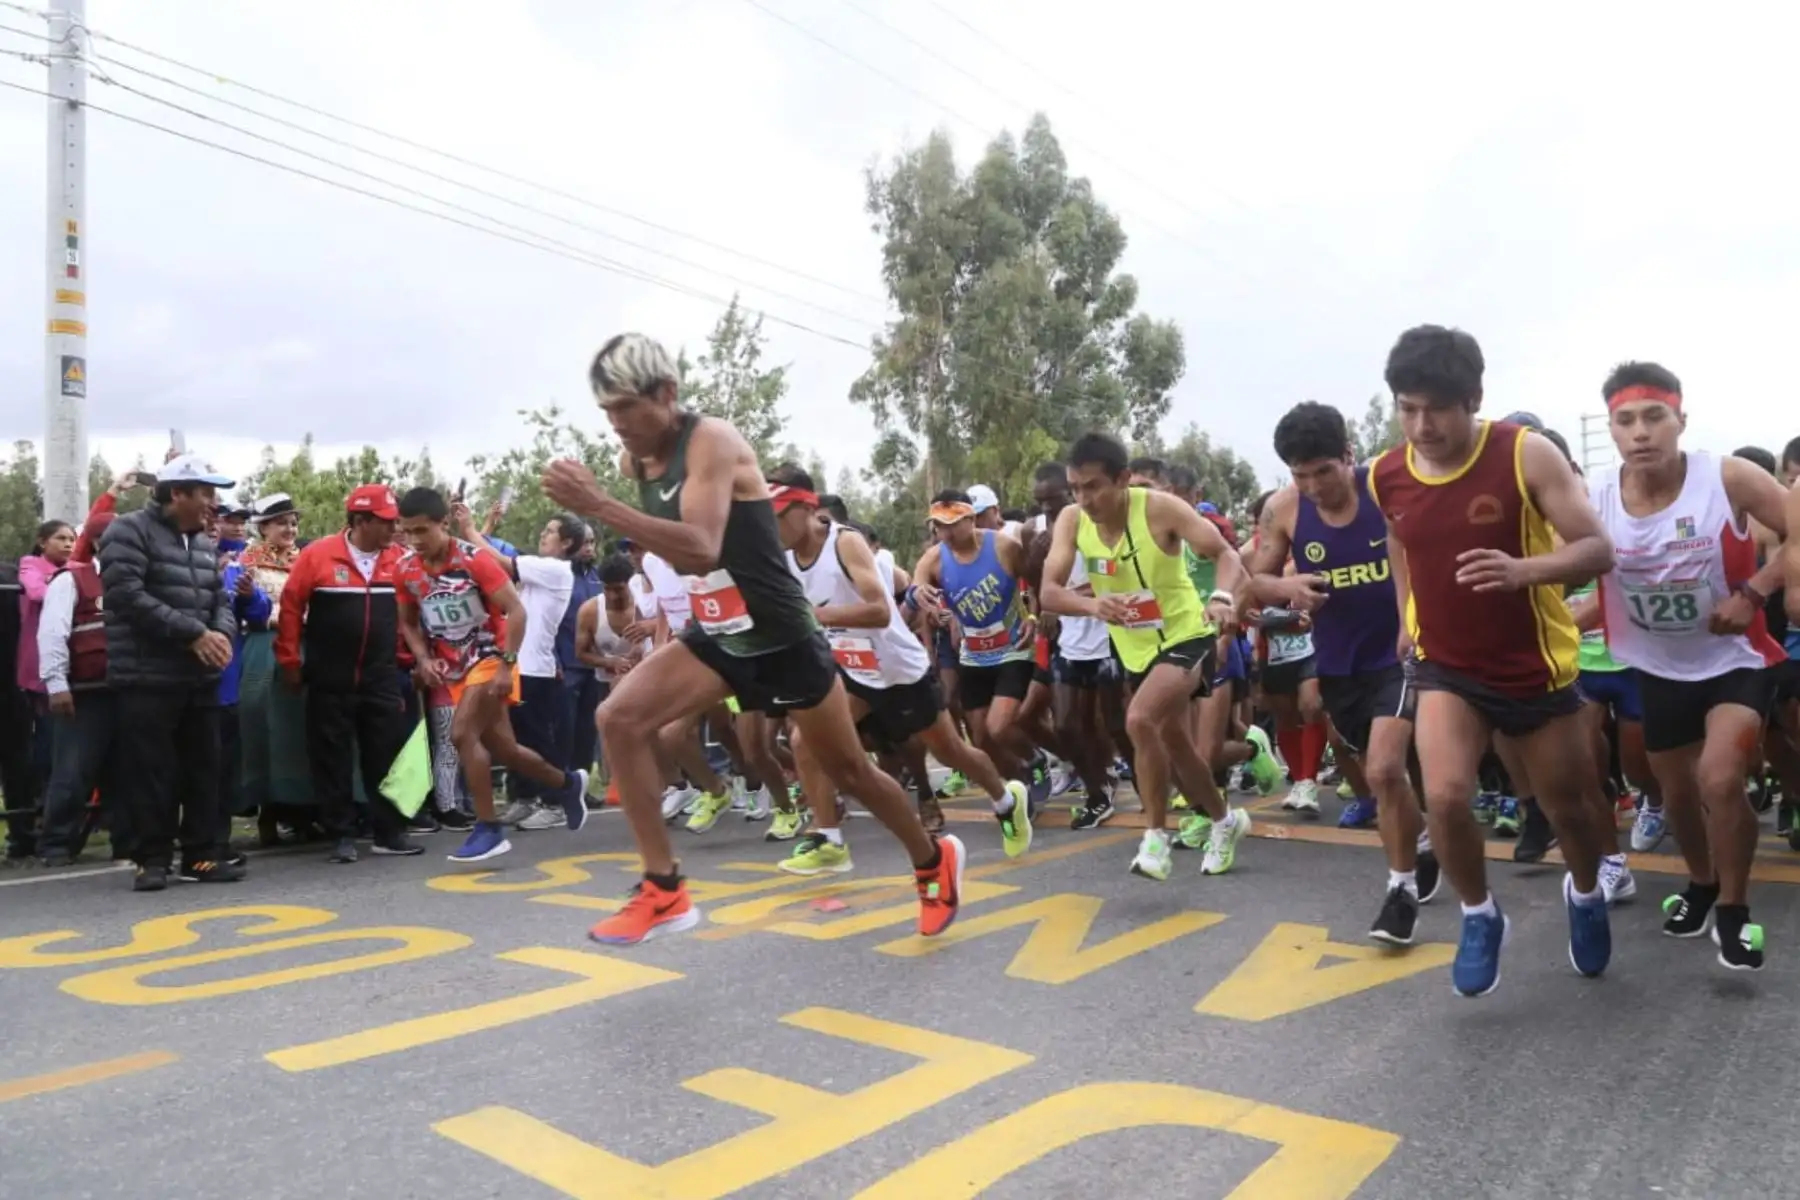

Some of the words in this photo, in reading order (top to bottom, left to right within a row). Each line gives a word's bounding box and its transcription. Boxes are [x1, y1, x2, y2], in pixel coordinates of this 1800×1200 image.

[956, 573, 1000, 617] PENTA
[971, 590, 1002, 622] RUN
[1627, 592, 1699, 623] 128
[431, 599, 473, 624] 161
